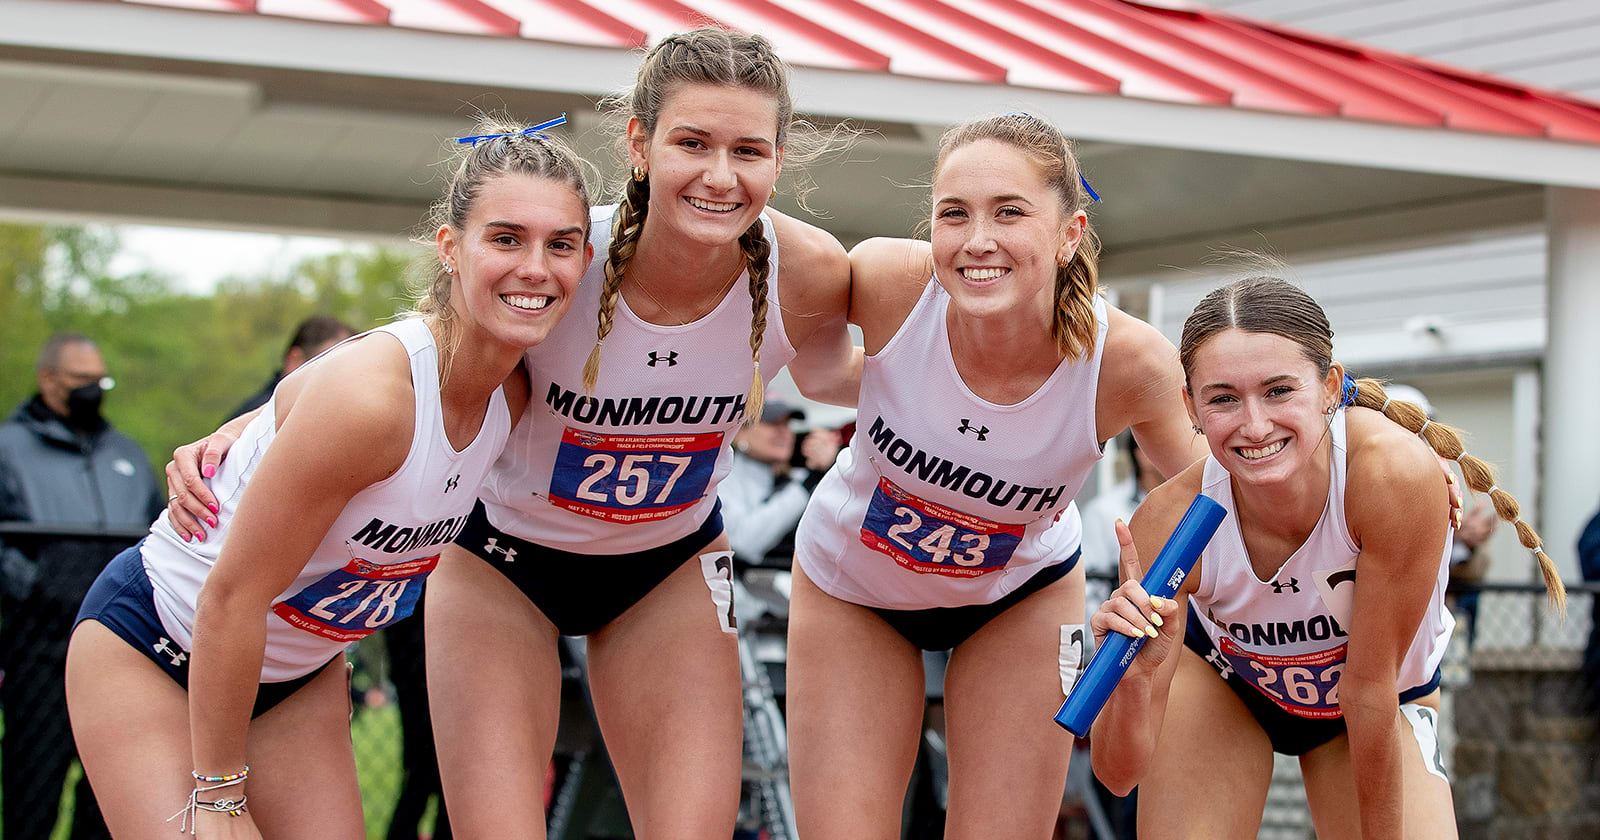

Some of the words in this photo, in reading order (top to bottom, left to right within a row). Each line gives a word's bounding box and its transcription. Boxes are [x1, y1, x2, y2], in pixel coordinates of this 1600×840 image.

[546, 381, 747, 427] MONMOUTH
[576, 453, 692, 506] 257
[868, 415, 1066, 512] MONMOUTH
[568, 504, 580, 512] MAY
[887, 506, 991, 568] 243
[308, 578, 411, 628] 278
[1250, 660, 1345, 705] 262
